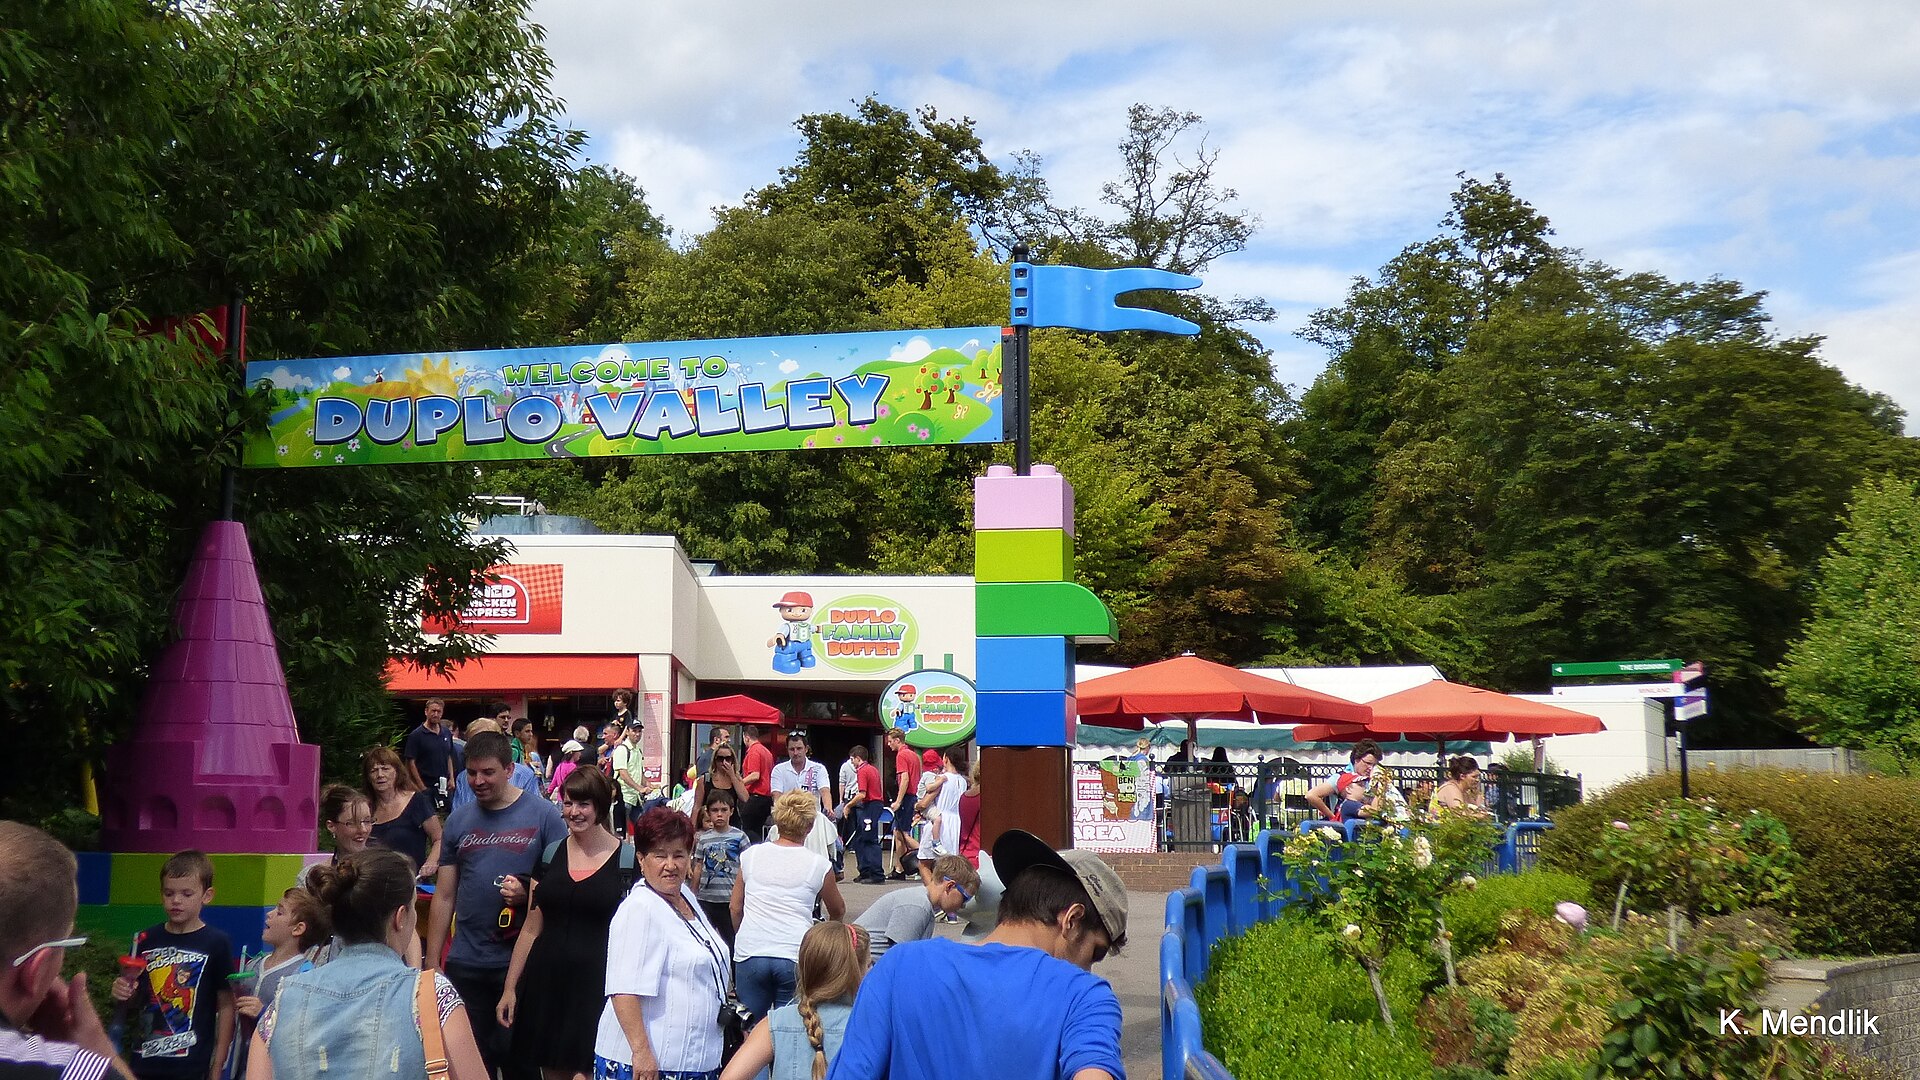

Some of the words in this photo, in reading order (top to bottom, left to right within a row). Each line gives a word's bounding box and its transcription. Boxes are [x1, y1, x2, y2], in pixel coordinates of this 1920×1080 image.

[502, 358, 670, 386] WELCOME
[679, 355, 728, 379] TO
[314, 395, 562, 445] DUPLO
[585, 374, 890, 440] VALLEY
[831, 610, 896, 623] DUPLO
[822, 624, 905, 640] FAMILY
[828, 642, 900, 656] BUFFET
[920, 704, 966, 714] FAMILY
[923, 714, 963, 723] BUFFET
[1118, 776, 1133, 784] BEN
[457, 833, 536, 848] Budweiser
[146, 954, 204, 972] CRUSADERS
